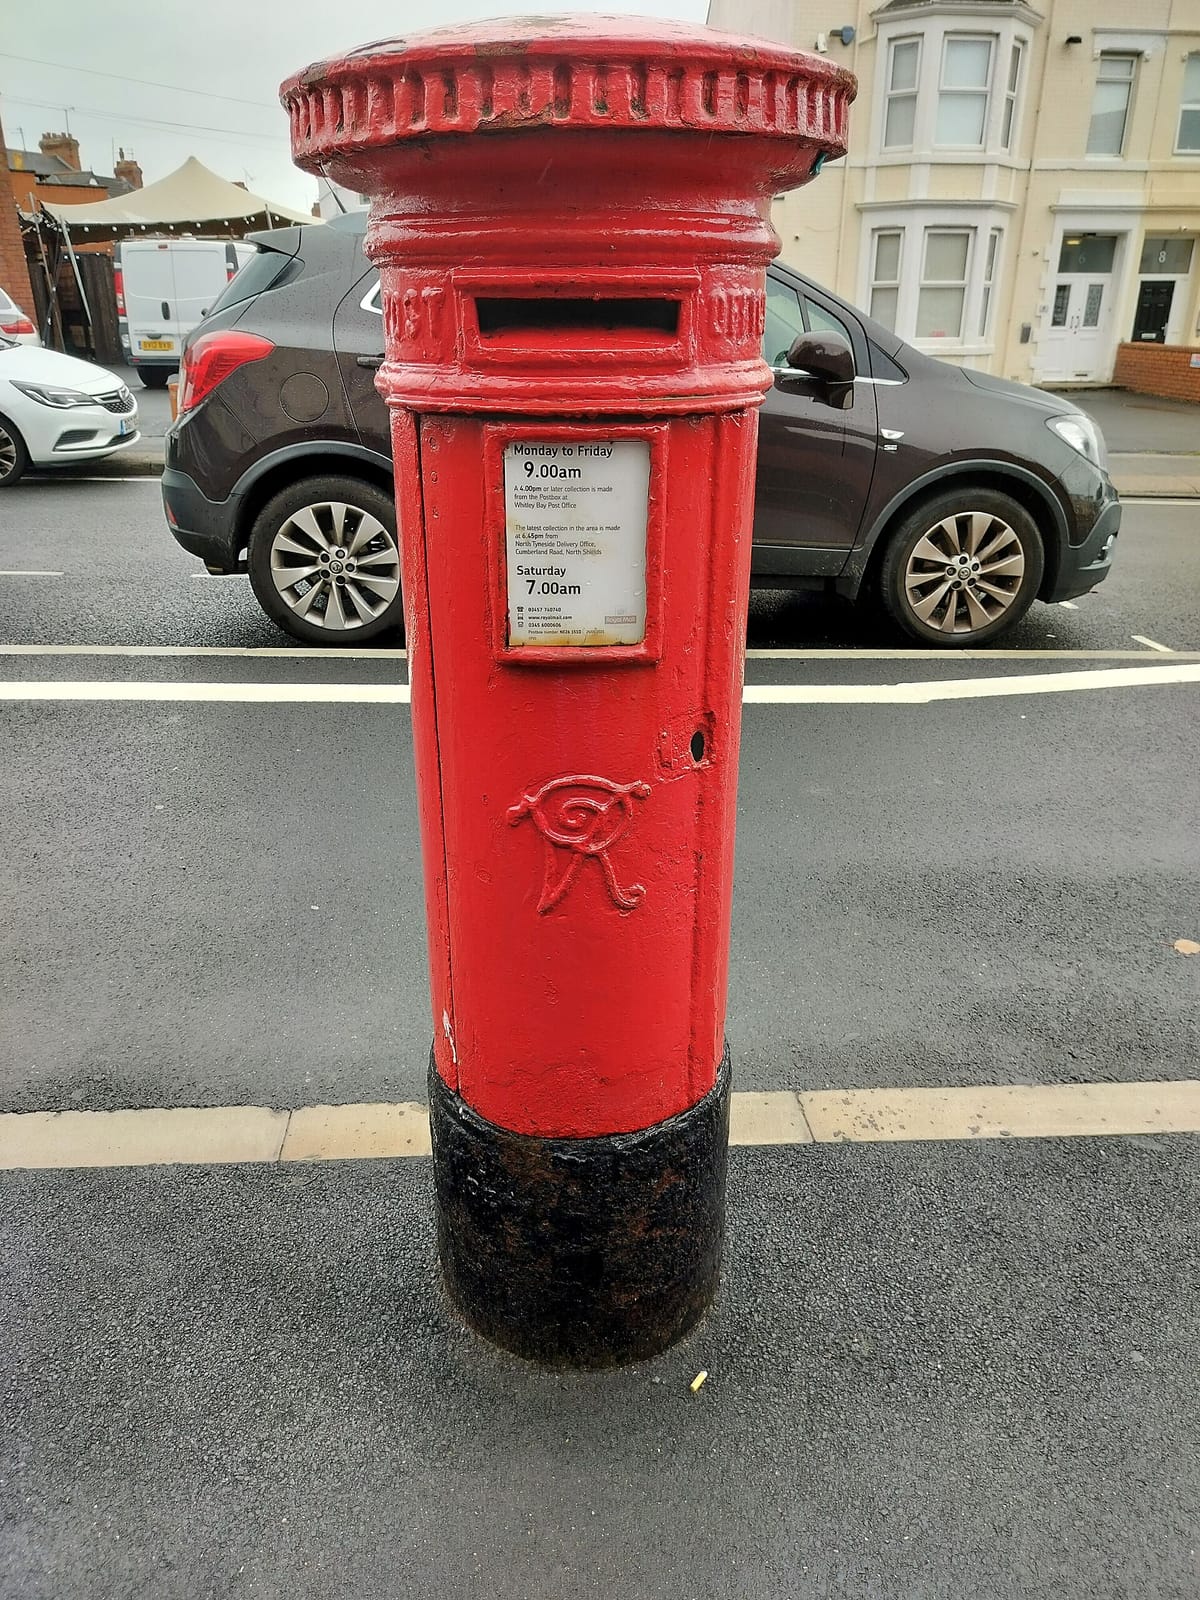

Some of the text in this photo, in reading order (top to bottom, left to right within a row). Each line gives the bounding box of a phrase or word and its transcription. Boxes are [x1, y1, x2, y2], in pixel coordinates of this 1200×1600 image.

[1158, 250, 1167, 263] 8
[514, 445, 613, 458] Monday to Friday
[524, 461, 581, 478] 9.00am
[516, 565, 567, 577] Saturday
[526, 580, 581, 595] 7.00am
